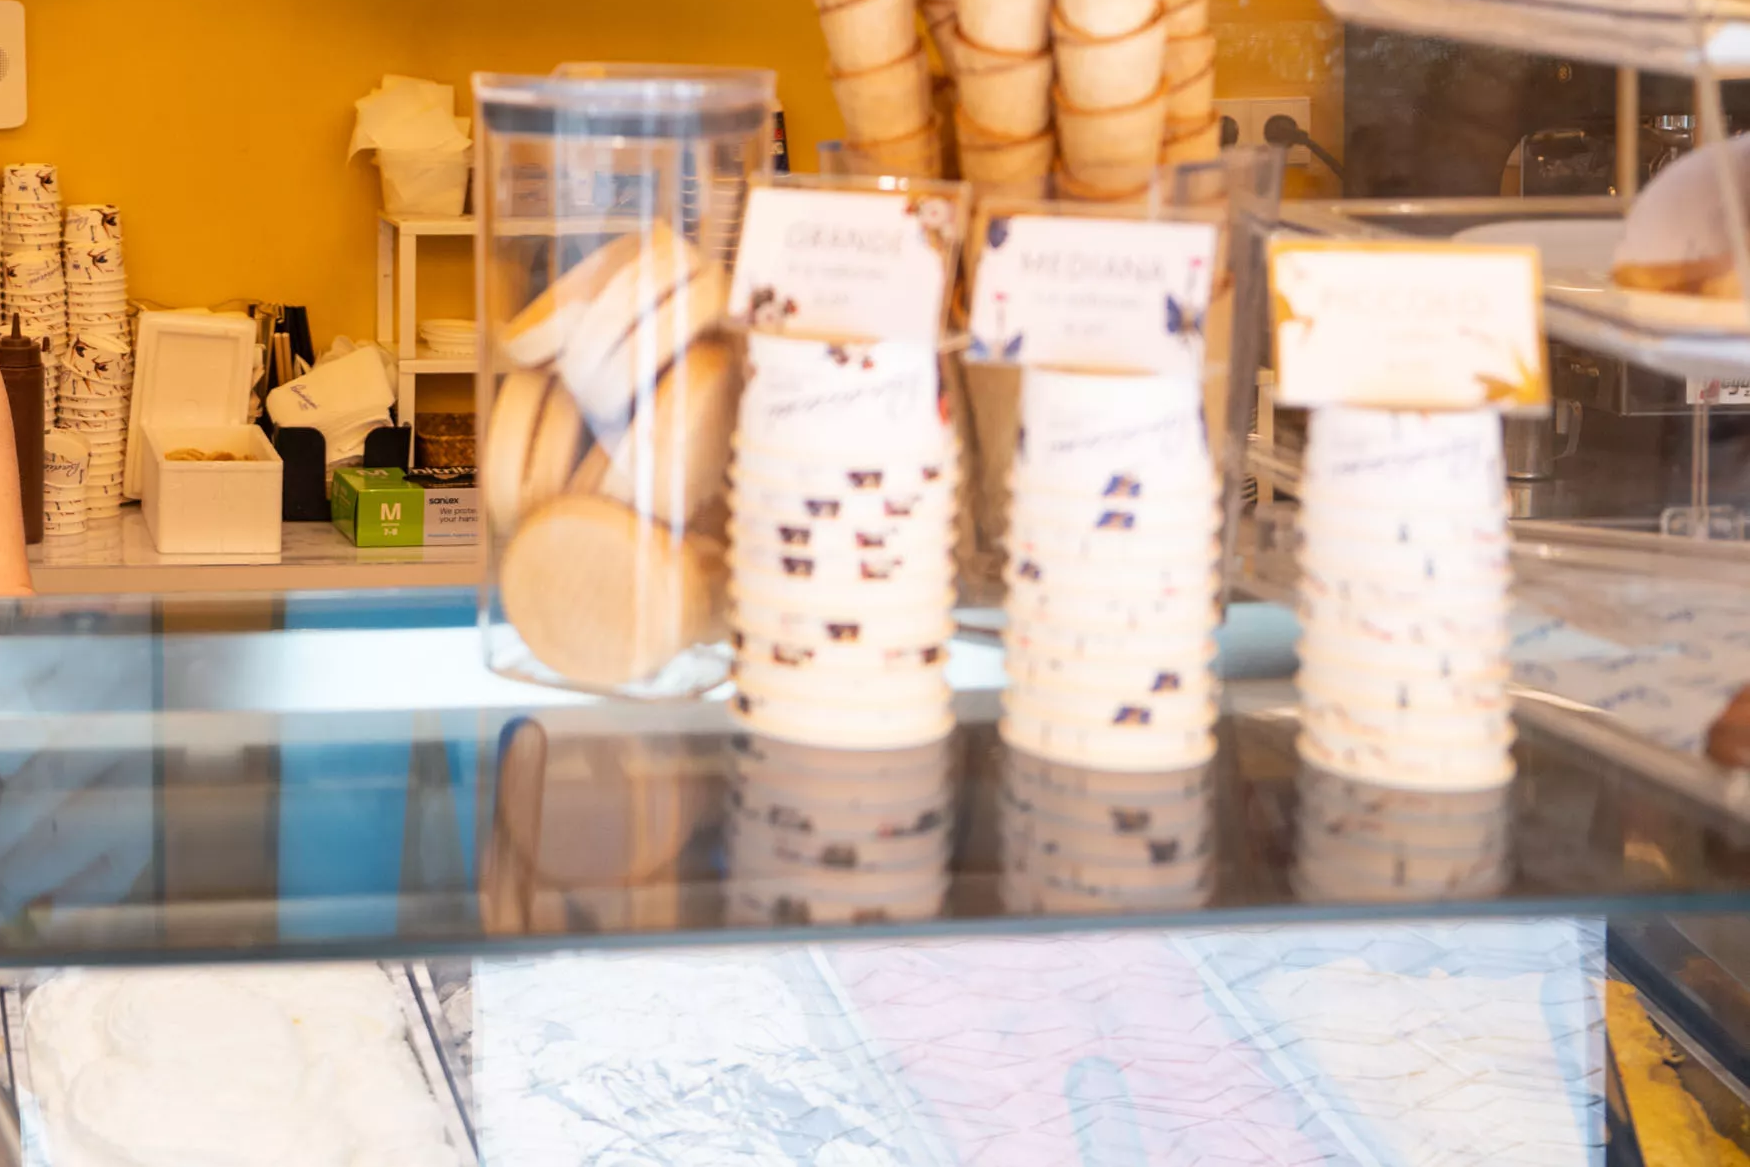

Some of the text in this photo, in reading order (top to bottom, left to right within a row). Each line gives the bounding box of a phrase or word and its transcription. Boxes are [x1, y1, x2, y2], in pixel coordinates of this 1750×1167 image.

[380, 503, 402, 521] M
[454, 508, 478, 516] prote
[439, 516, 457, 524] your
